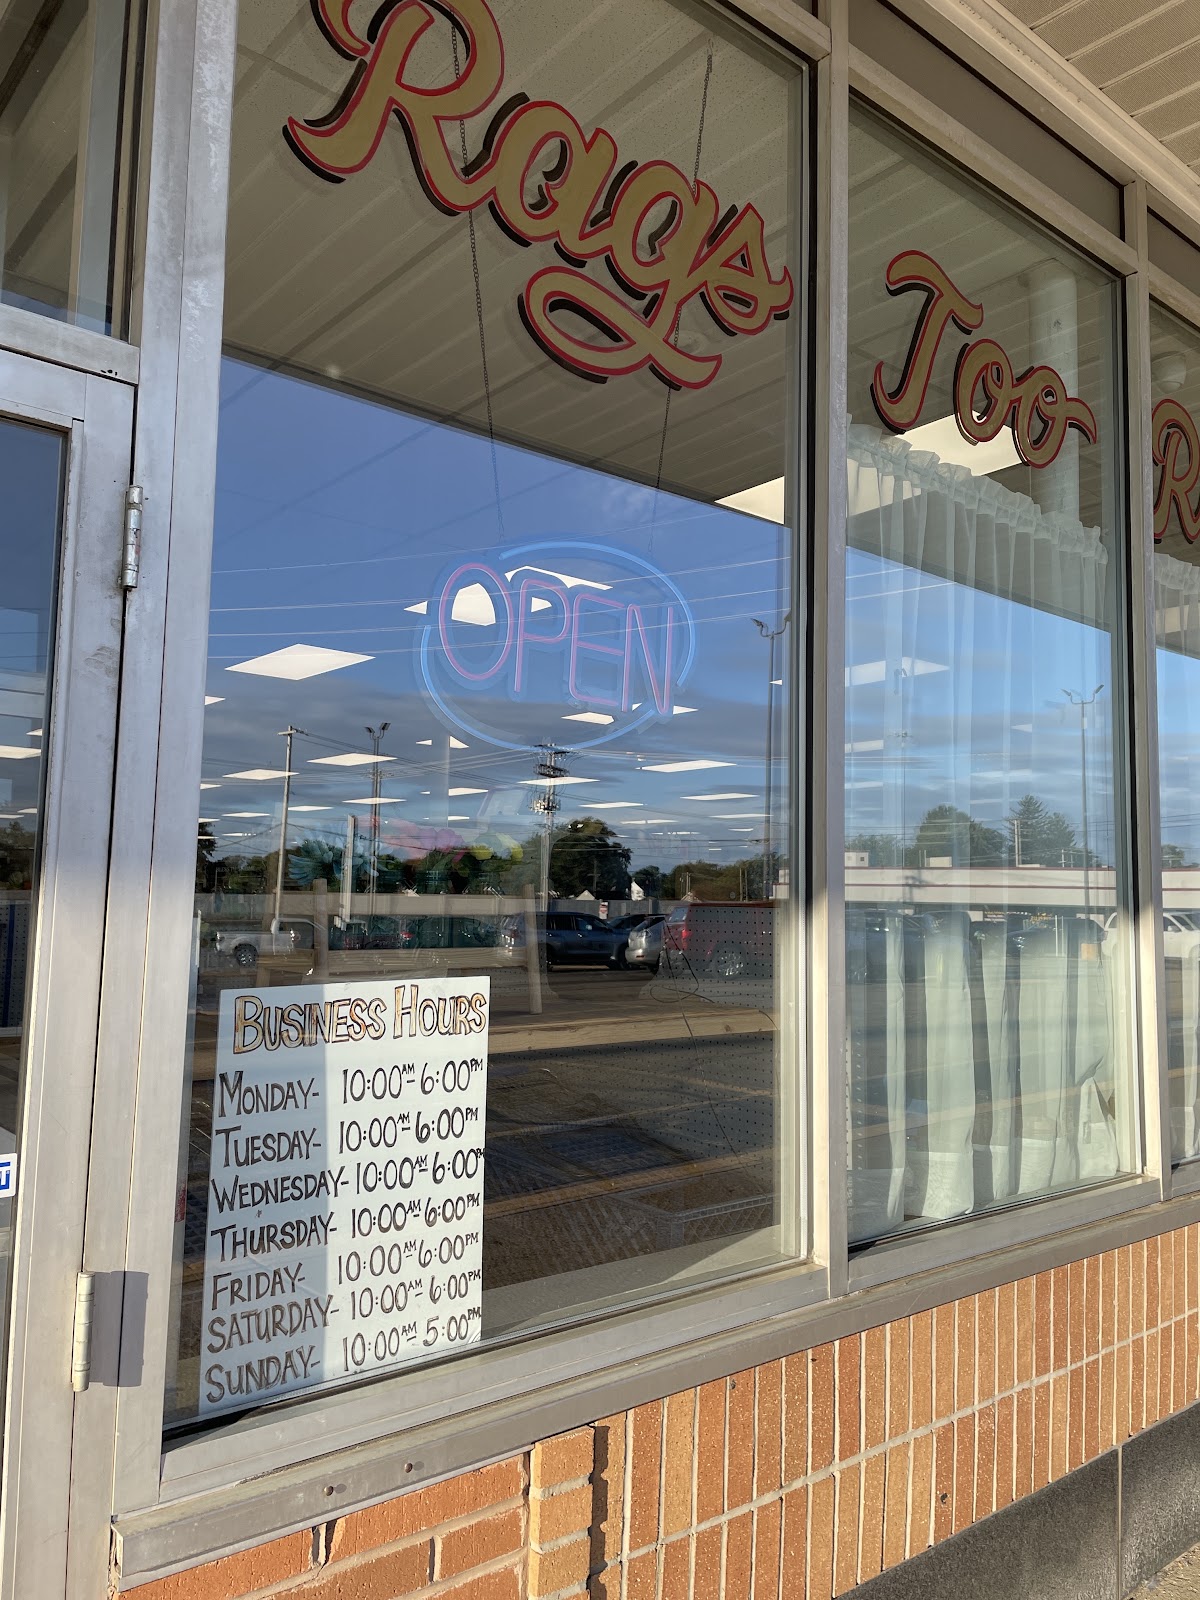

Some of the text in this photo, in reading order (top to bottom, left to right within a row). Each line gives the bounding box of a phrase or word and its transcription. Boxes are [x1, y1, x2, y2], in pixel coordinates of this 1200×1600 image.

[282, 0, 795, 391] Rags
[870, 250, 1097, 469] Too
[437, 562, 675, 715] OPEN
[233, 984, 487, 1054] BUSINESS HOURS
